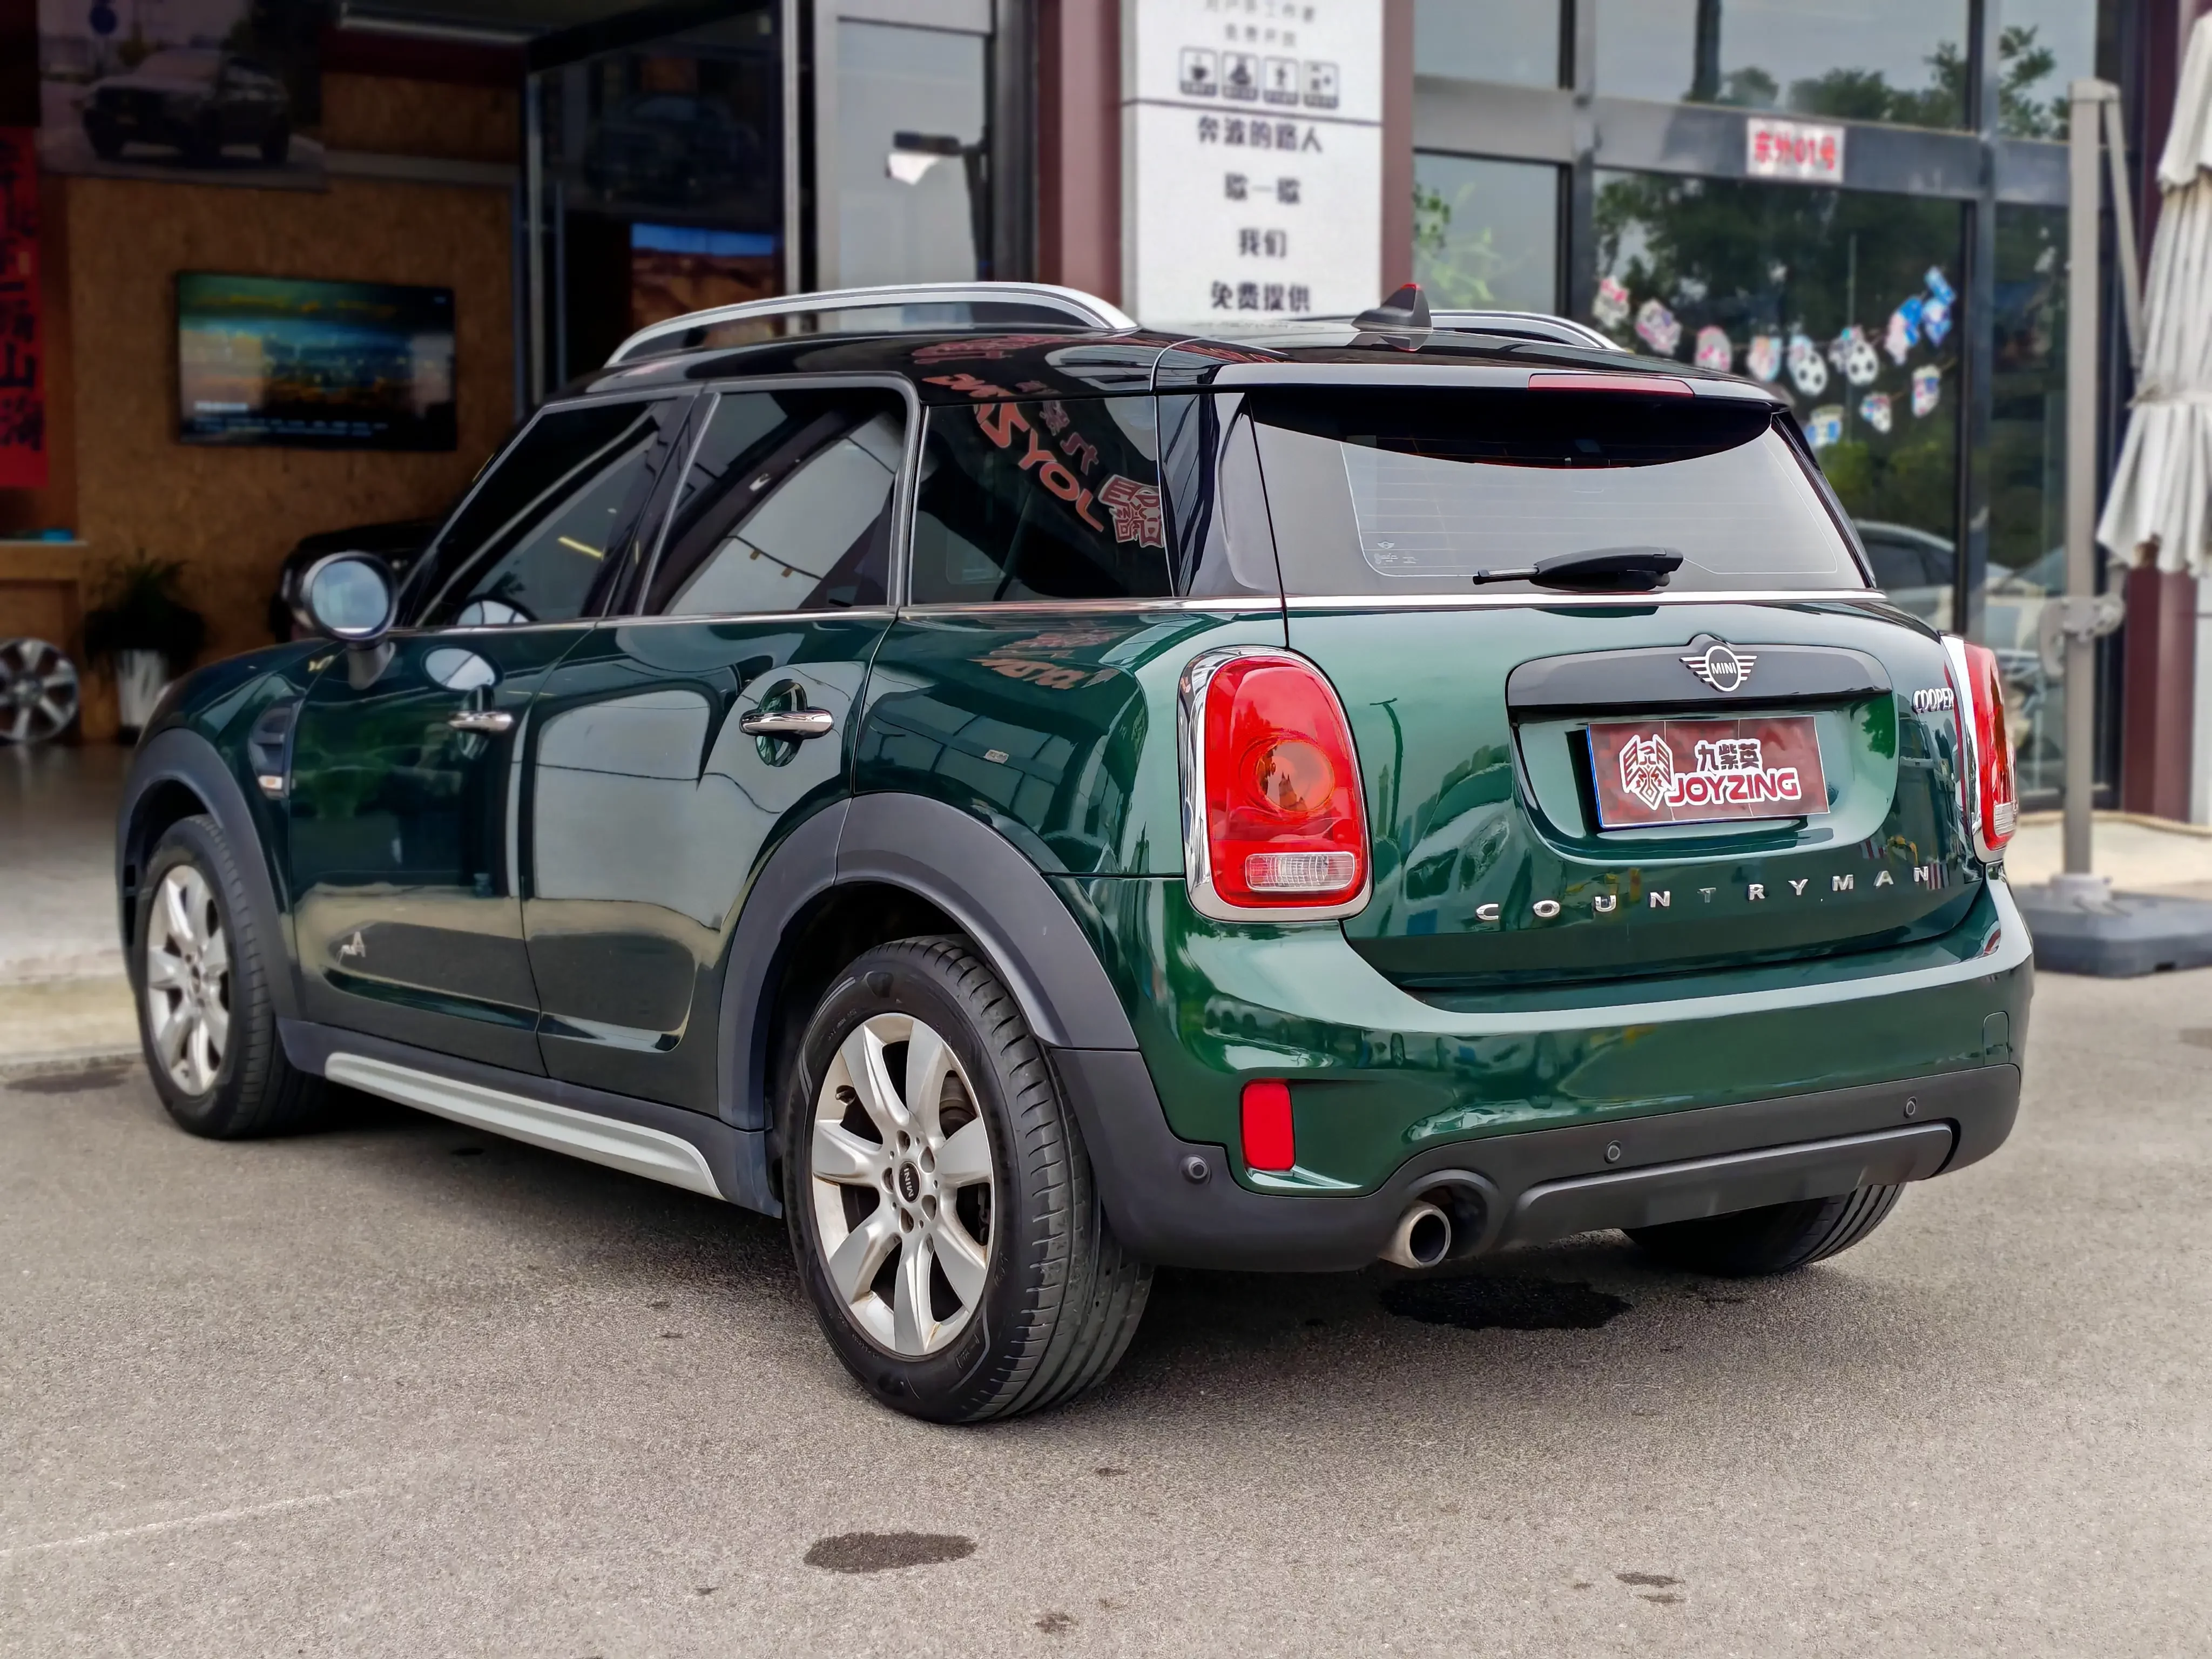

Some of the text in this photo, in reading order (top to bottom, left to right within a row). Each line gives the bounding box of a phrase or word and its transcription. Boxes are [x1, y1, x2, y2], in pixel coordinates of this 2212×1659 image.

[1239, 227, 1287, 259] 我们
[1211, 280, 1311, 312] 免费提供
[1711, 662, 1737, 674] MINI
[1912, 687, 1954, 713] COOPER
[1697, 742, 1761, 771] 九紫英
[1667, 771, 1800, 803] JOYZING
[1475, 865, 1929, 922] COUNTRYMAN
[903, 1168, 914, 1198] MINI
